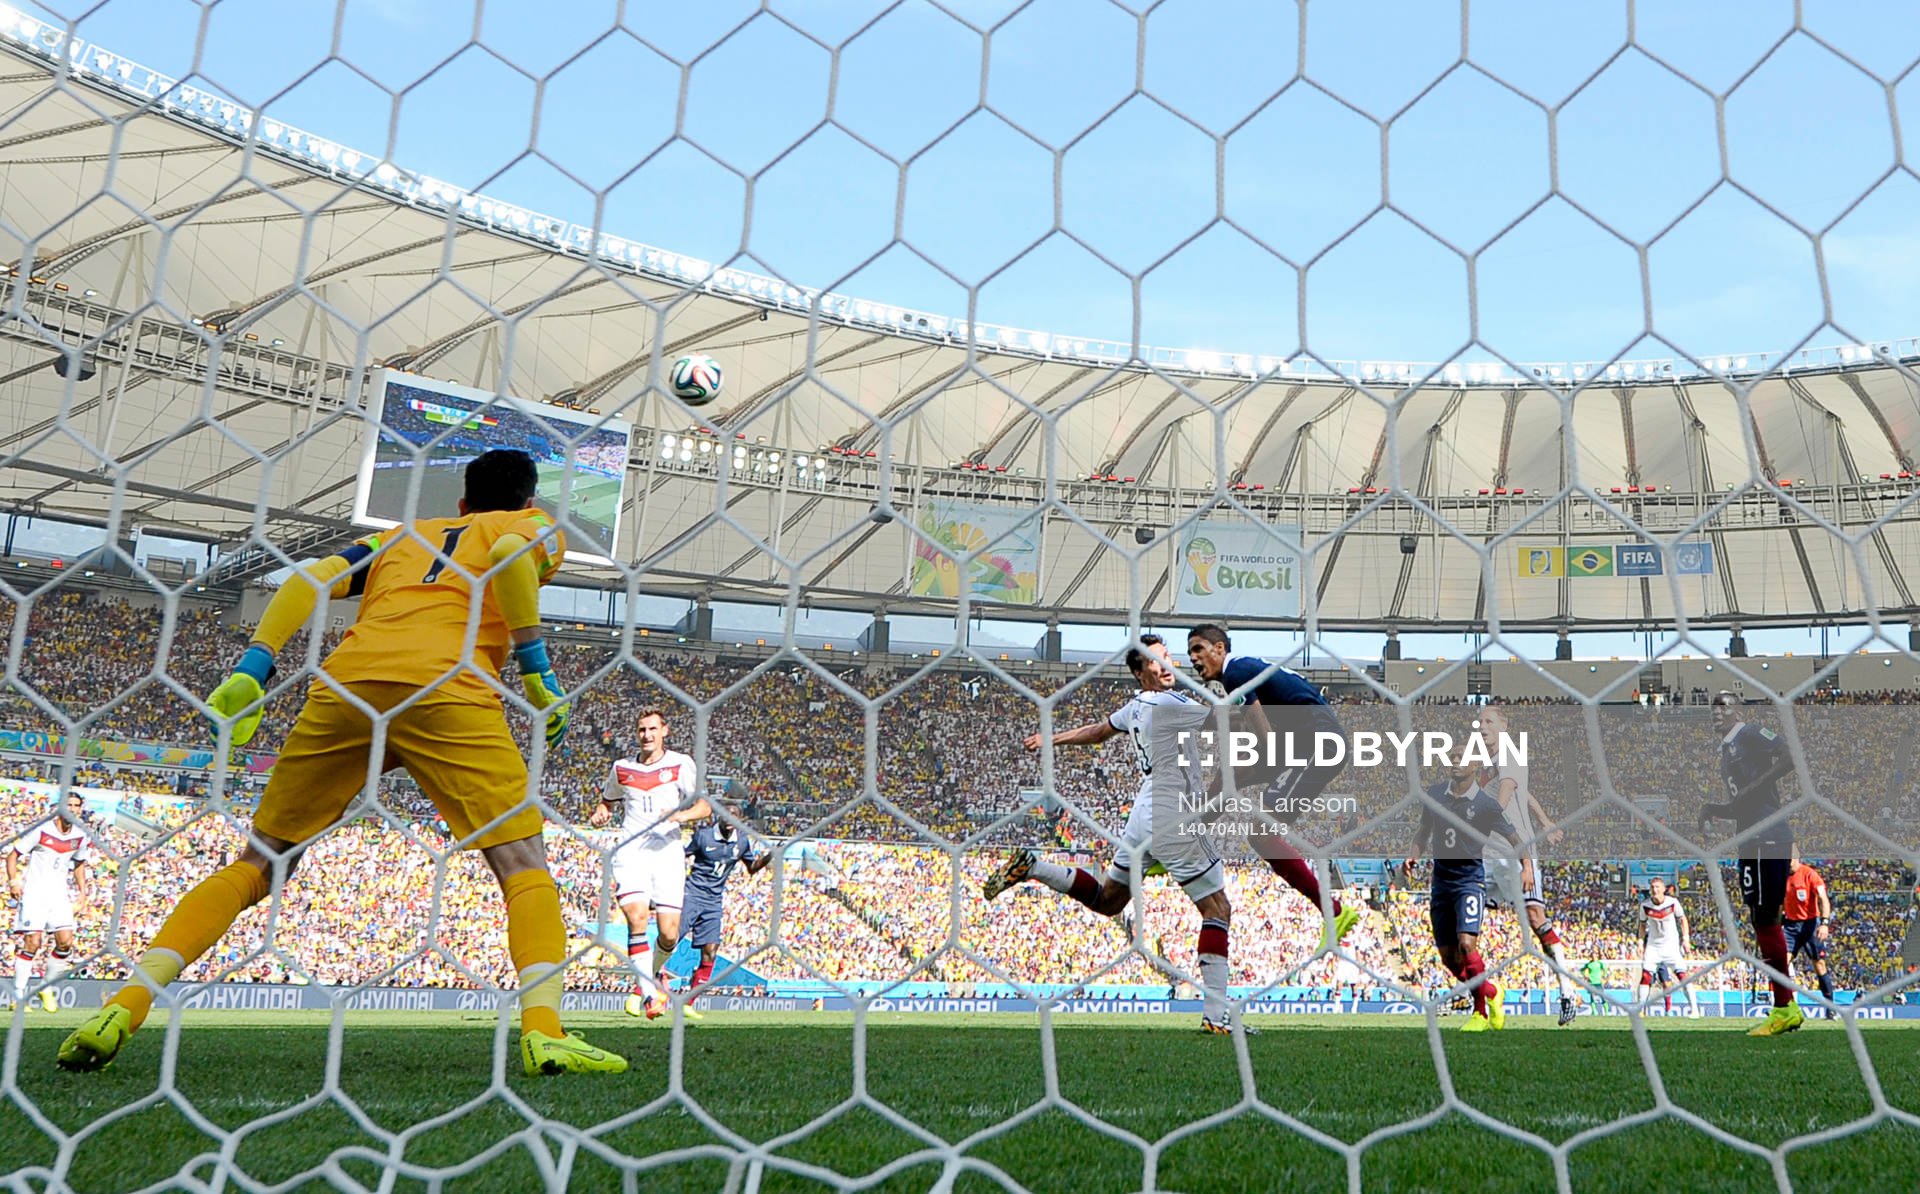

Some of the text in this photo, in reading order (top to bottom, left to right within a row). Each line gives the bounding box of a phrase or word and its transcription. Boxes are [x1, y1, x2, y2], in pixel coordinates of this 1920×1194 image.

[1220, 554, 1294, 564] FIFA WORLD CUP
[1623, 551, 1655, 564] FIFA
[1217, 565, 1292, 590] Brasil
[1444, 828, 1456, 848] 3
[1743, 866, 1753, 887] 5
[1466, 896, 1478, 916] 3
[213, 987, 303, 1009] HYUNDAI
[360, 990, 434, 1010] HYUNDAI
[900, 1000, 998, 1012] HYUNDAI
[1073, 1001, 1170, 1013] HYUNDAI
